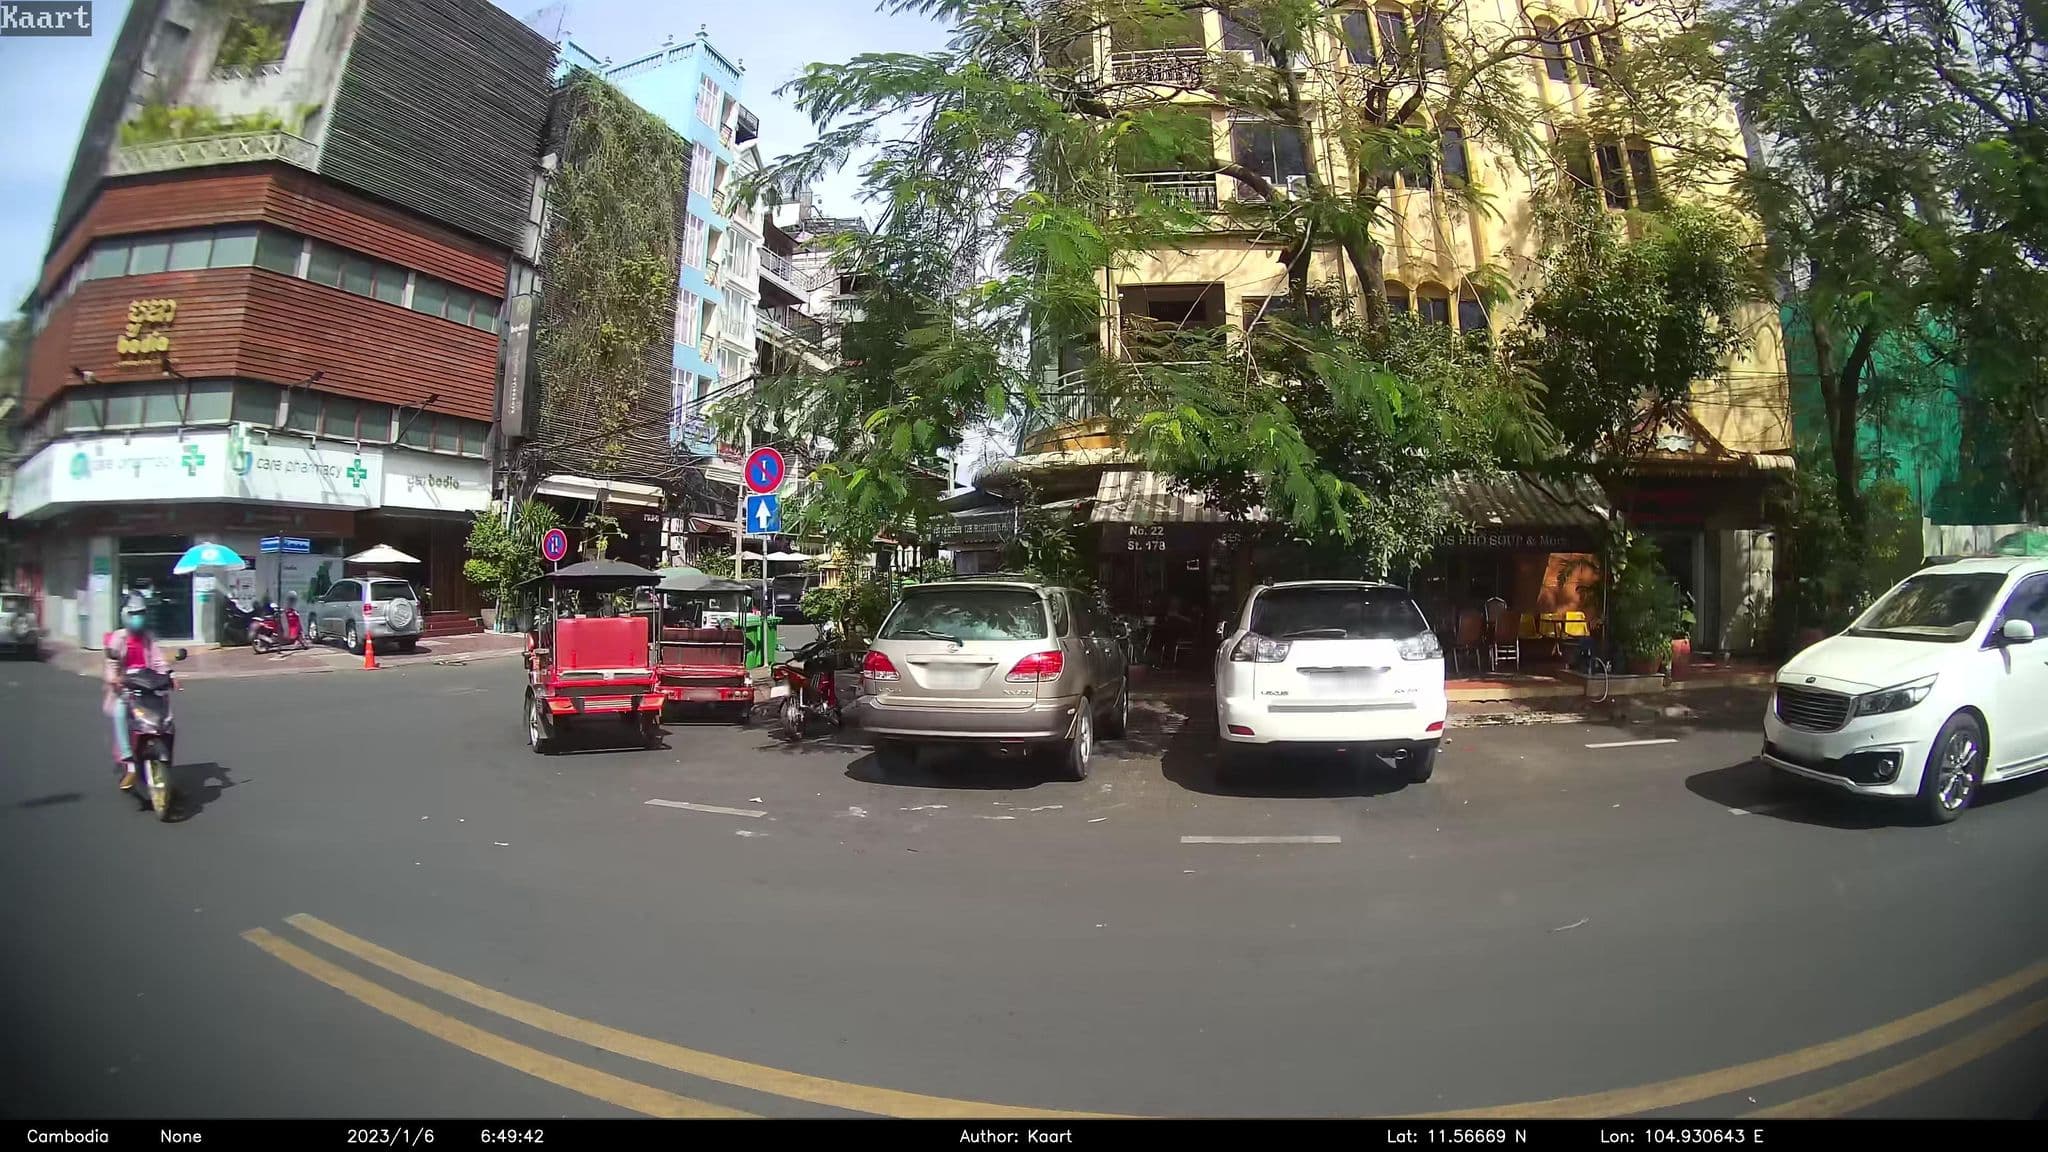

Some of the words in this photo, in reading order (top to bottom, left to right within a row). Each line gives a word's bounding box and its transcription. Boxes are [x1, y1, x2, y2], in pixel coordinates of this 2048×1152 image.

[1129, 526, 1147, 536] No.
[1151, 526, 1165, 536] 22
[1127, 541, 1142, 551] St.
[1146, 541, 1166, 551] 178
